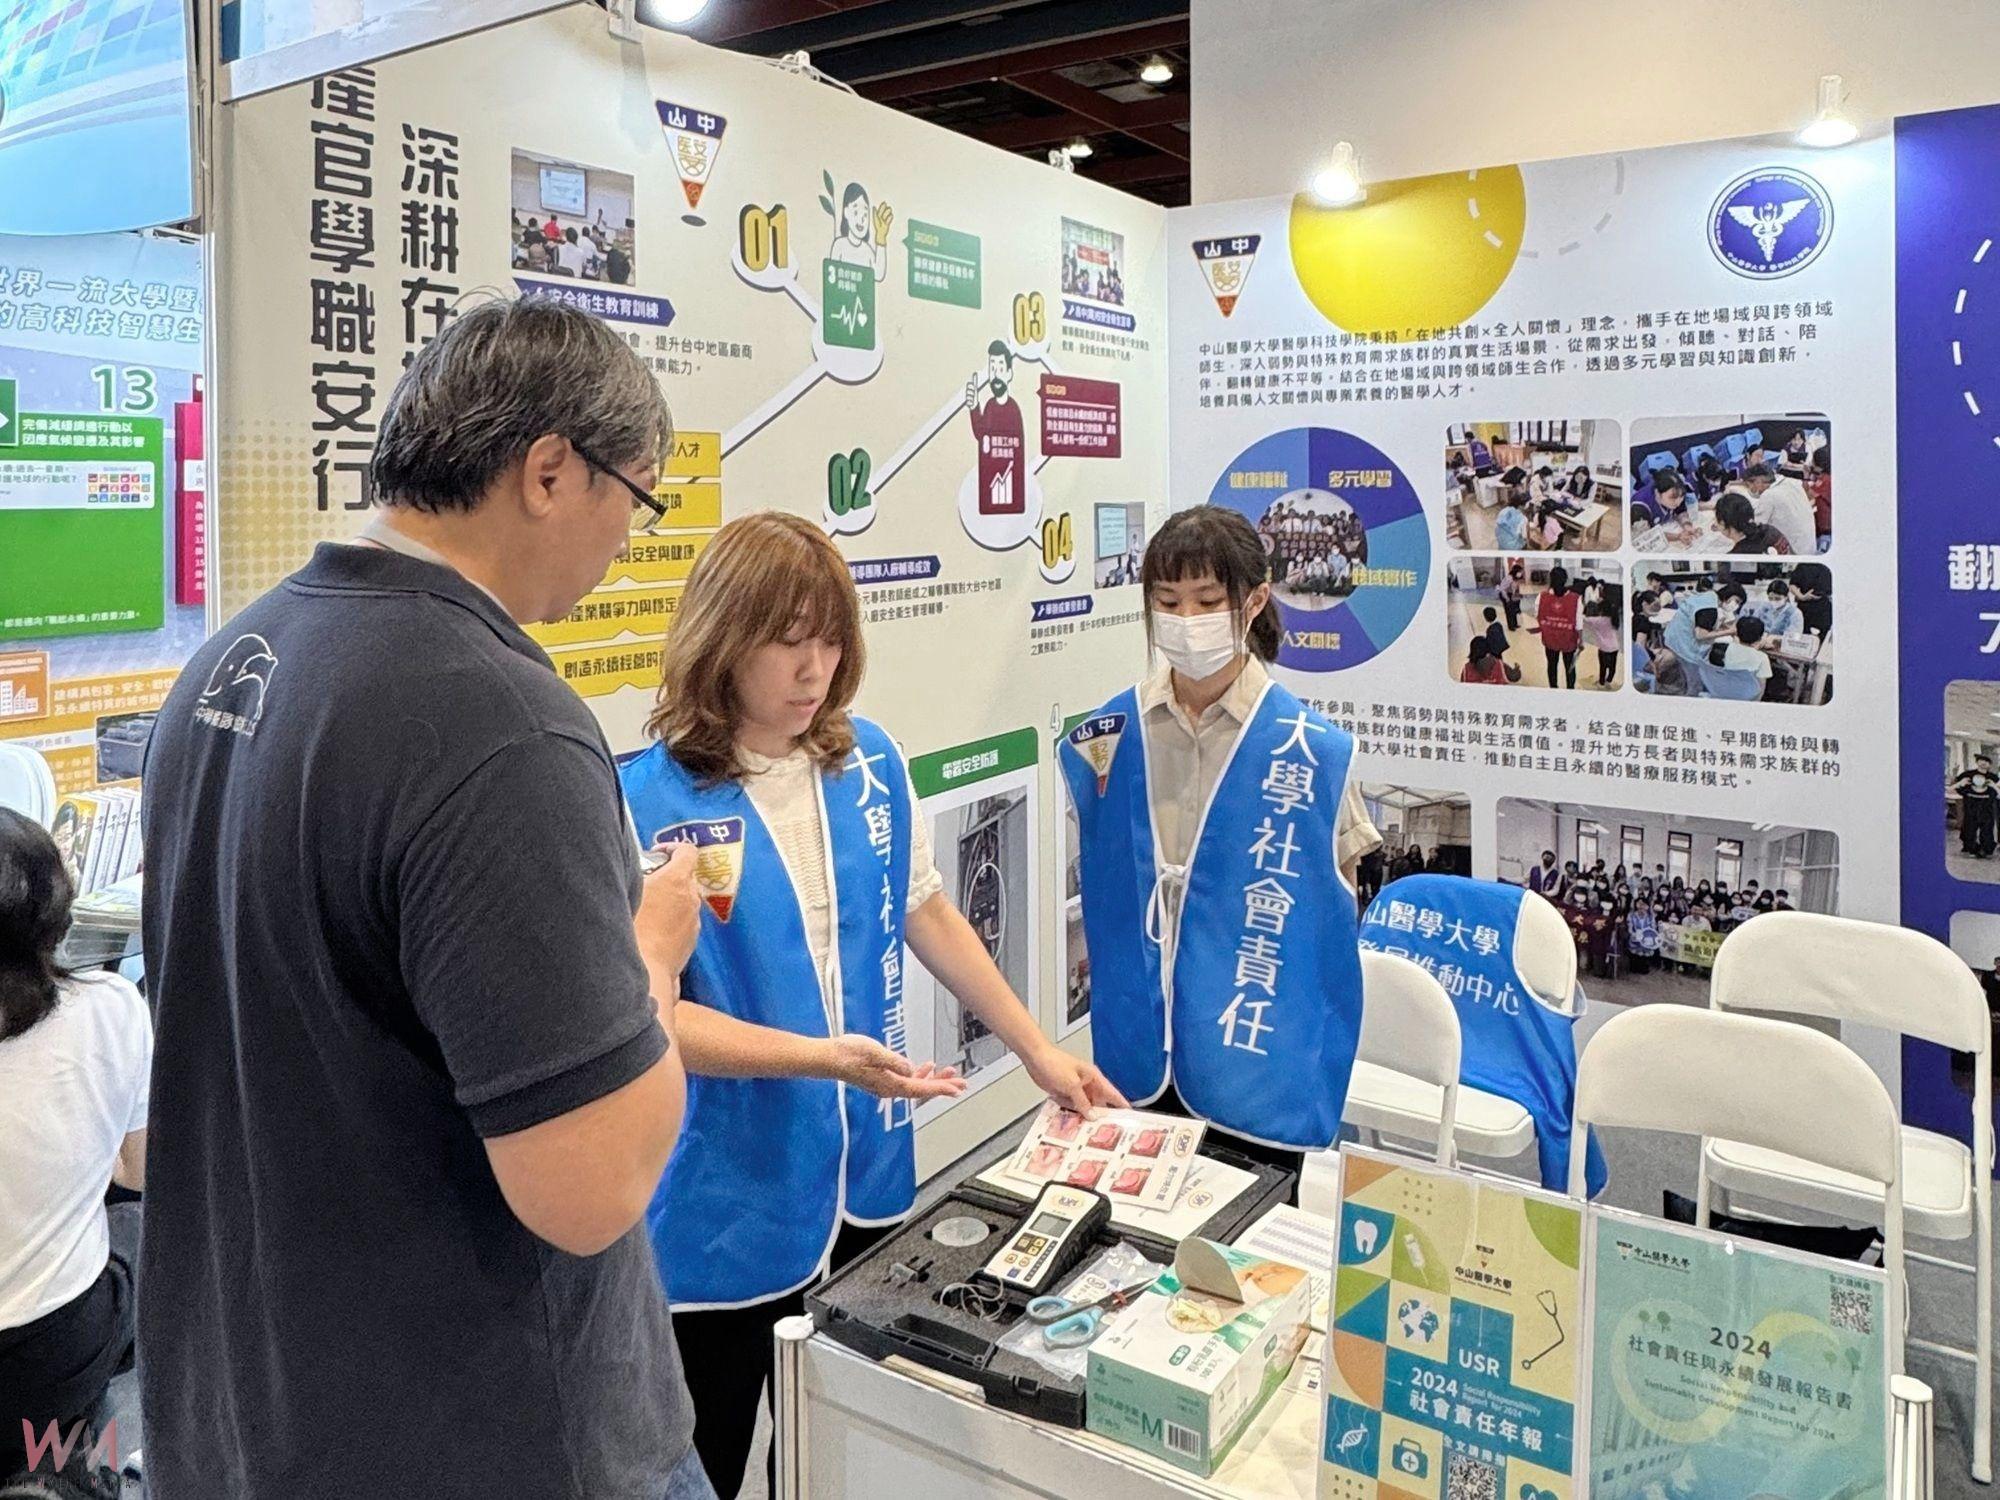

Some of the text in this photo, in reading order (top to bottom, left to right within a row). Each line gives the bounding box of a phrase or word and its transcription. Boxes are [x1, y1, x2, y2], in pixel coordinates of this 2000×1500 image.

[402, 122, 459, 375] 深耕在
[740, 204, 789, 272] 01
[1013, 291, 1046, 346] 03
[92, 366, 157, 413] 13
[828, 447, 871, 517] 02
[1327, 469, 1393, 488] 多元學習
[1042, 512, 1074, 570] 04
[1217, 710, 1328, 1057] 大學社會責任
[1458, 1347, 1500, 1378] USR
[1709, 1326, 1772, 1360] 2024
[1410, 1367, 1459, 1399] 2024
[1628, 1334, 1853, 1411] 社會責任與永續發展報告書
[1142, 1411, 1162, 1441] M
[1409, 1390, 1544, 1453] 社會責任年報
